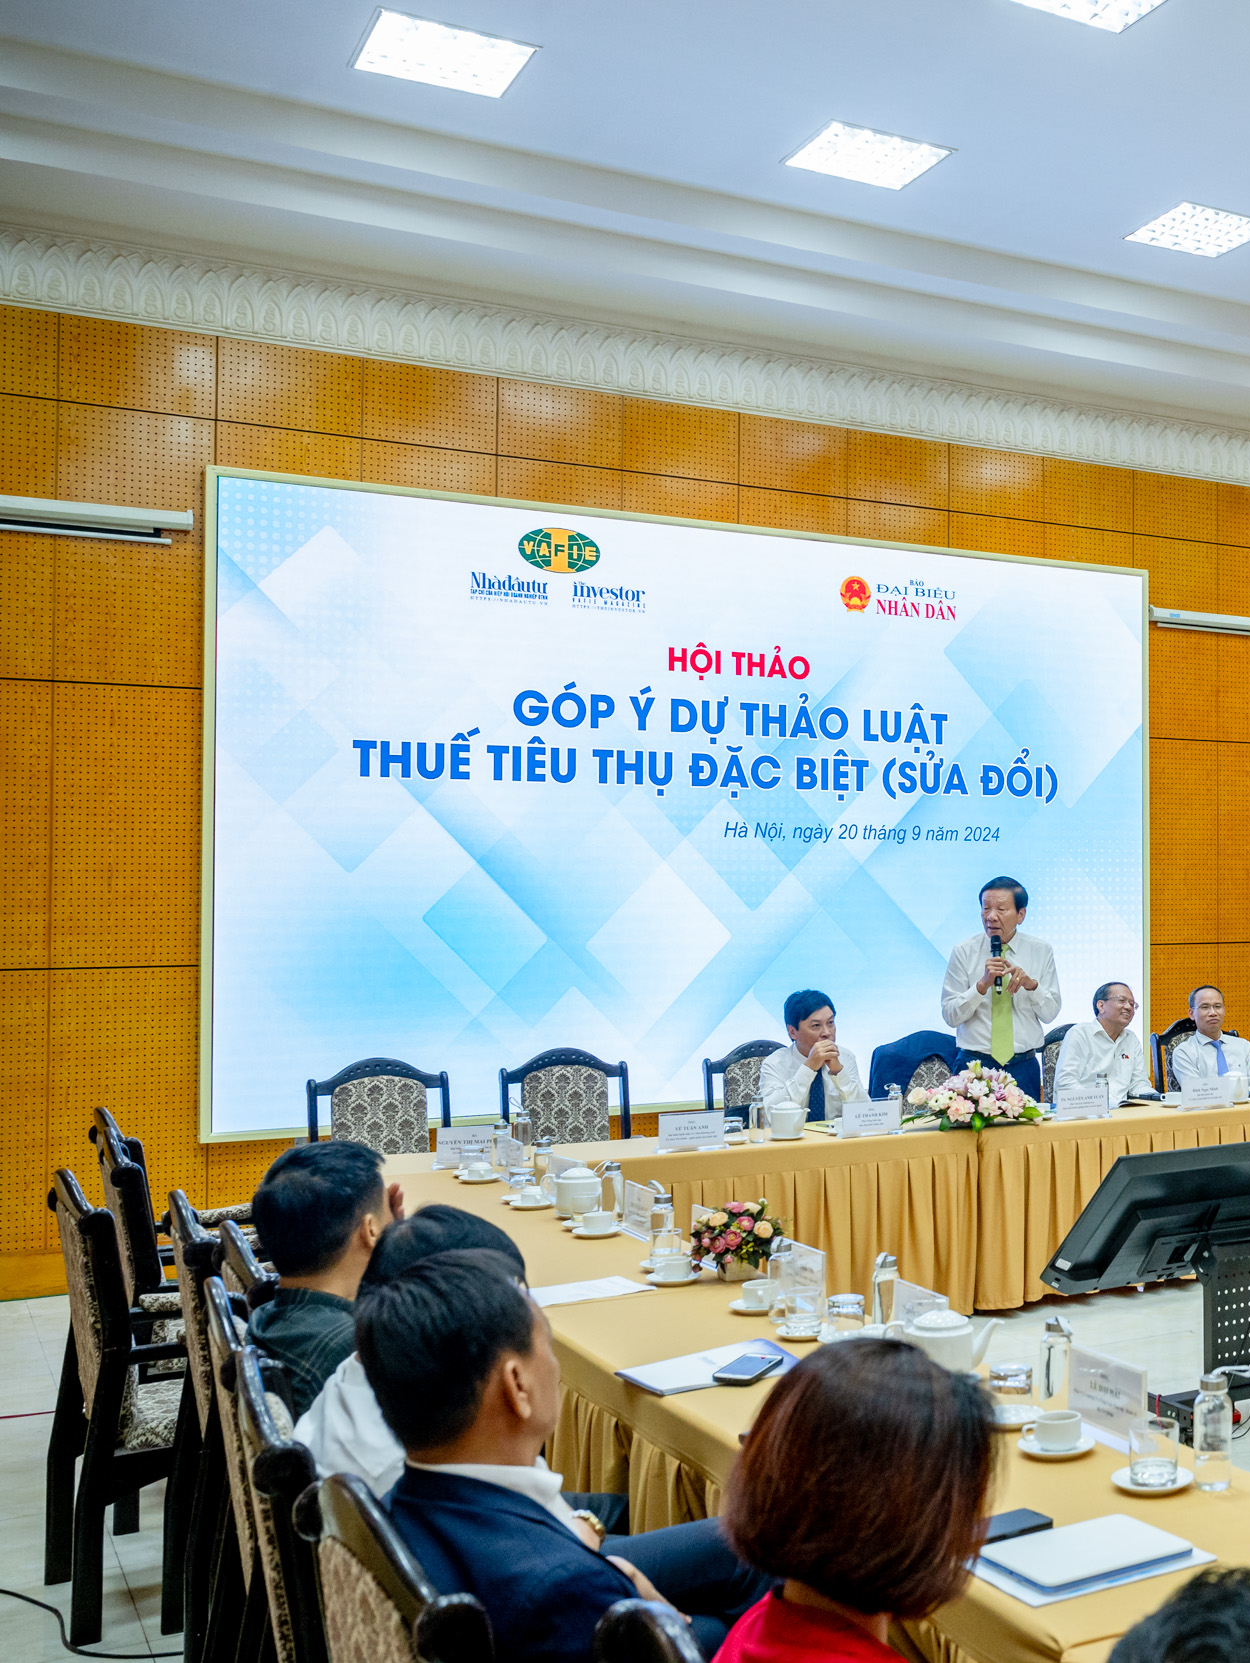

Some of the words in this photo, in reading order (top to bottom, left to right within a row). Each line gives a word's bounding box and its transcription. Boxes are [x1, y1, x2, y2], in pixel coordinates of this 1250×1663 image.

[523, 541, 596, 560] VAFIE
[573, 581, 645, 602] investor
[876, 584, 908, 596] ĐẠI
[876, 596, 920, 618] NHÂN
[925, 600, 956, 621] DÂN
[668, 642, 721, 680] HỘI
[731, 646, 810, 680] THẢO
[513, 681, 615, 729] GÓP
[629, 685, 656, 731] Ý
[670, 696, 729, 745] DỰ
[740, 692, 849, 740] THẢO
[863, 702, 948, 754] LUẬT
[352, 726, 480, 780] THUẾ
[486, 736, 577, 784] TIÊU
[592, 749, 673, 796] THỤ
[688, 744, 782, 798] ĐẶC
[796, 748, 870, 801] BIỆT
[882, 749, 969, 800] (SỬA
[980, 747, 1058, 804] ĐỔI)
[724, 822, 748, 838] Hà
[754, 822, 786, 842] Nội,
[793, 824, 834, 843] ngày
[838, 824, 858, 840] 20
[863, 824, 906, 843] tháng
[912, 826, 921, 841] 9
[925, 826, 959, 841] năm
[964, 827, 1000, 842] 2024
